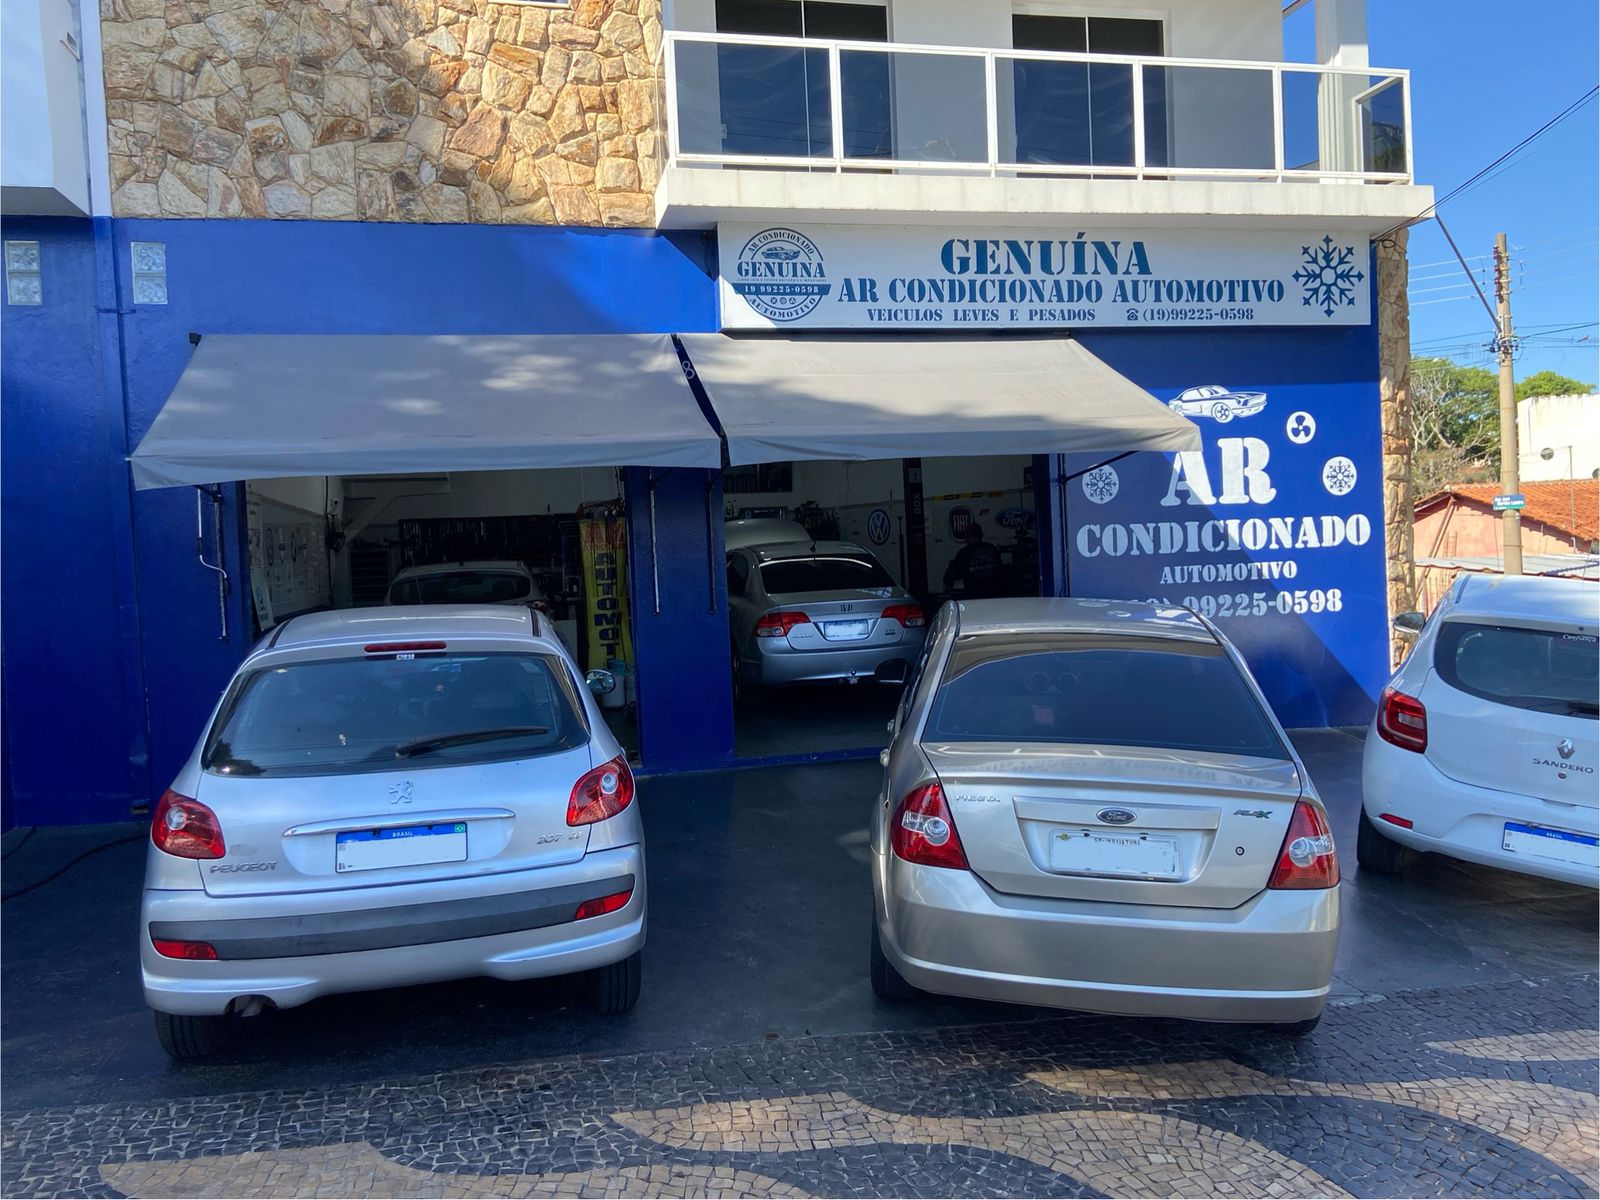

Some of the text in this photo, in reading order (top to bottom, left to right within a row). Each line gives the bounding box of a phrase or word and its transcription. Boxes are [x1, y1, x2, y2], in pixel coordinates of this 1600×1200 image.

[748, 231, 815, 254] AR CONDICIONADO
[941, 232, 1152, 275] GENUÍNA
[744, 285, 819, 293] 19 99225-0598
[838, 278, 1285, 304] AR CONDICIONADO AUTOMOTIVO
[749, 297, 816, 318] AUTOMOTIVO
[867, 307, 1254, 322] VEICULOS LEVES E PESADOS (19)99225-0598
[1160, 437, 1277, 507] AR
[1076, 513, 1371, 558] CONDICIONADO
[1160, 560, 1298, 585] AUTOMOTIVO
[1182, 588, 1343, 620] 99225-0598
[1531, 758, 1594, 774] SANDERO
[955, 793, 1001, 803] FIESTA
[1106, 810, 1128, 821] Ford
[536, 833, 562, 845] 207
[209, 861, 278, 874] PEUGEOT
